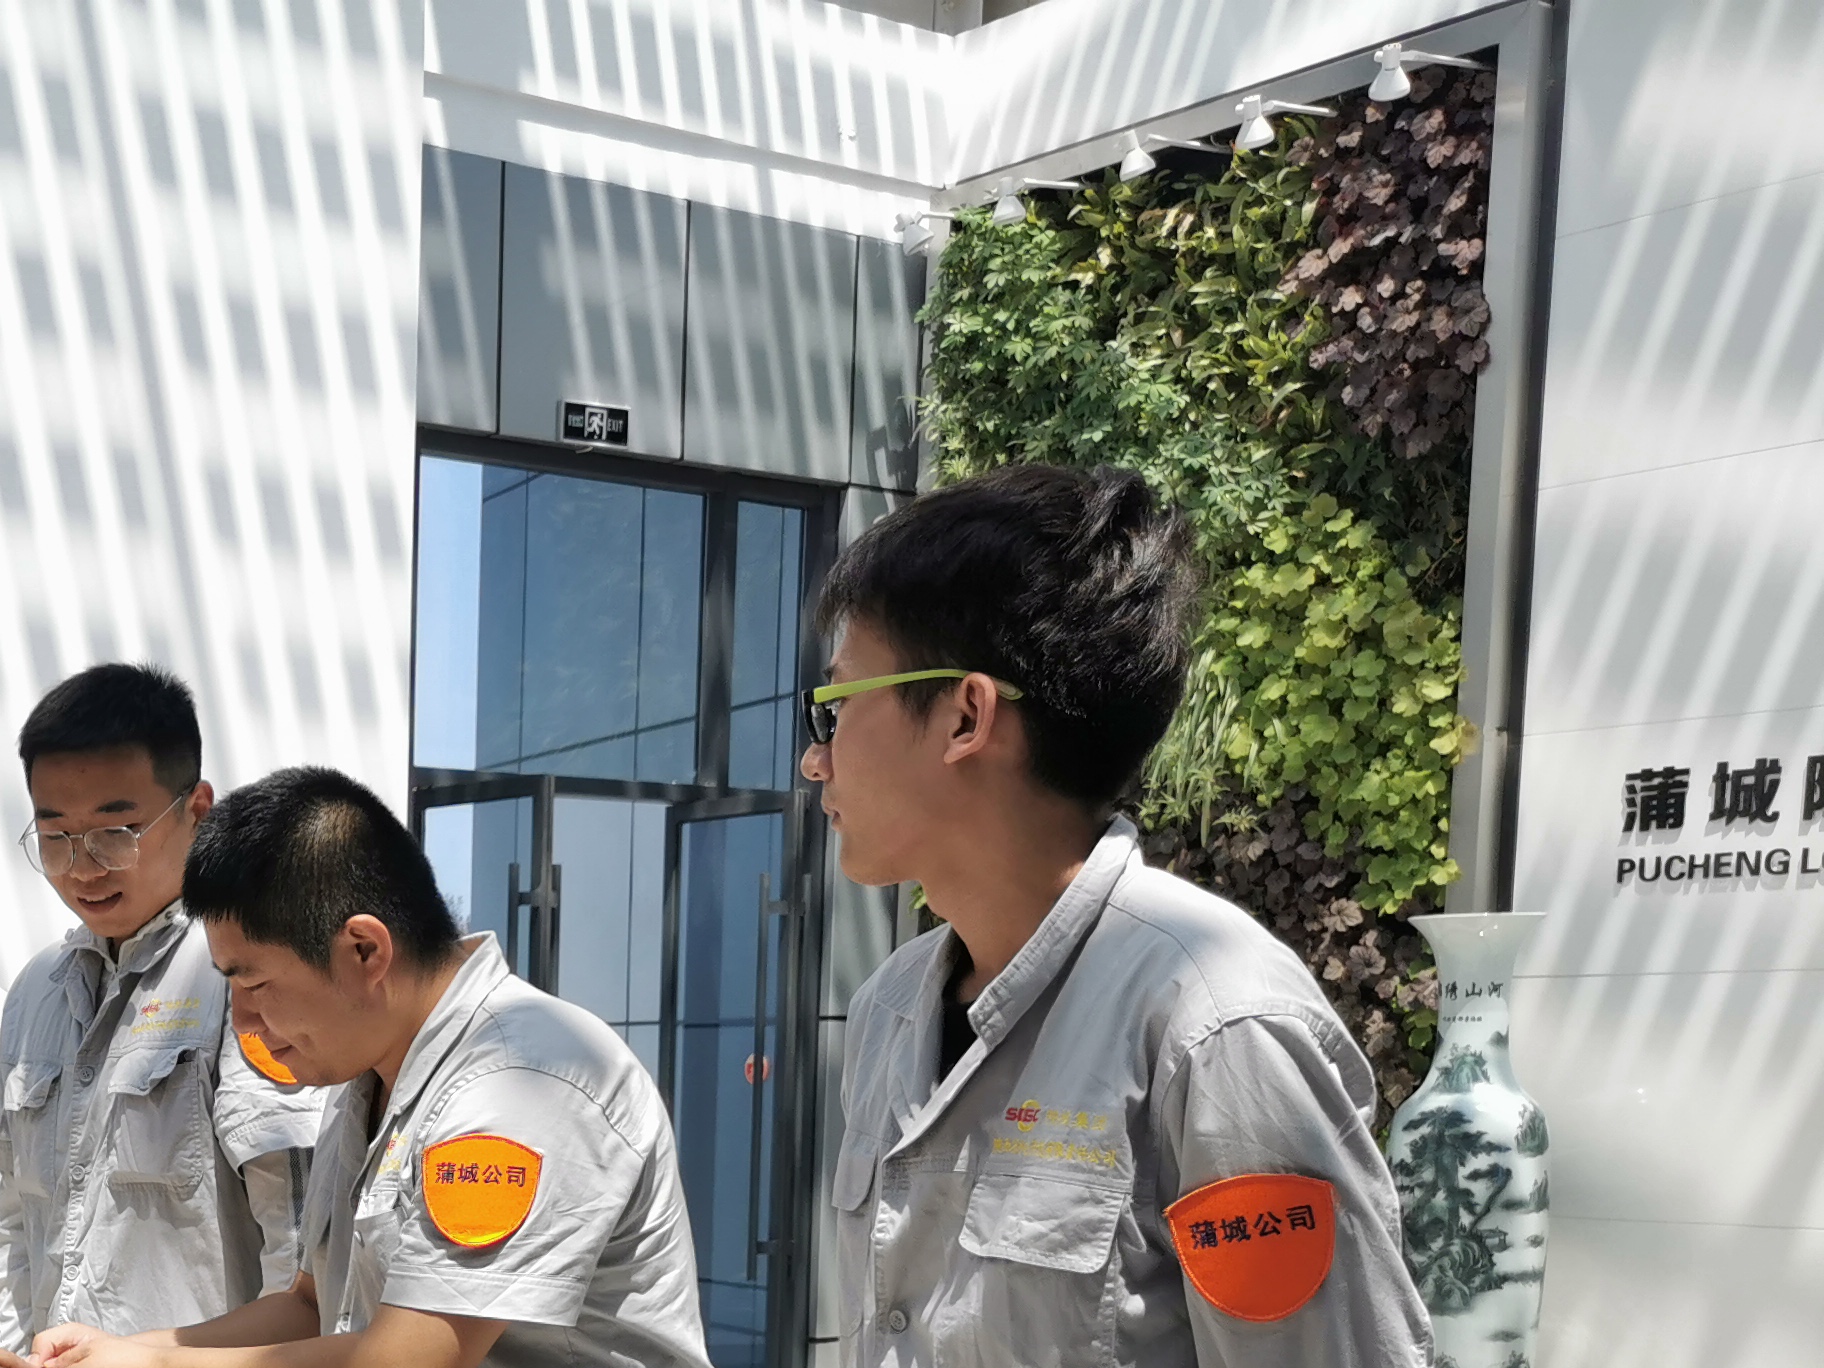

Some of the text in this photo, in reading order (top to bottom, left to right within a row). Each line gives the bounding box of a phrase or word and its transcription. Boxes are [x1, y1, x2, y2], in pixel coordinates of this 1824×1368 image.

[607, 418, 624, 433] EXIT
[1616, 846, 1824, 884] PUCHENG L
[435, 1162, 527, 1188] 蒲城公司
[1188, 1204, 1317, 1250] 蒲城公司
